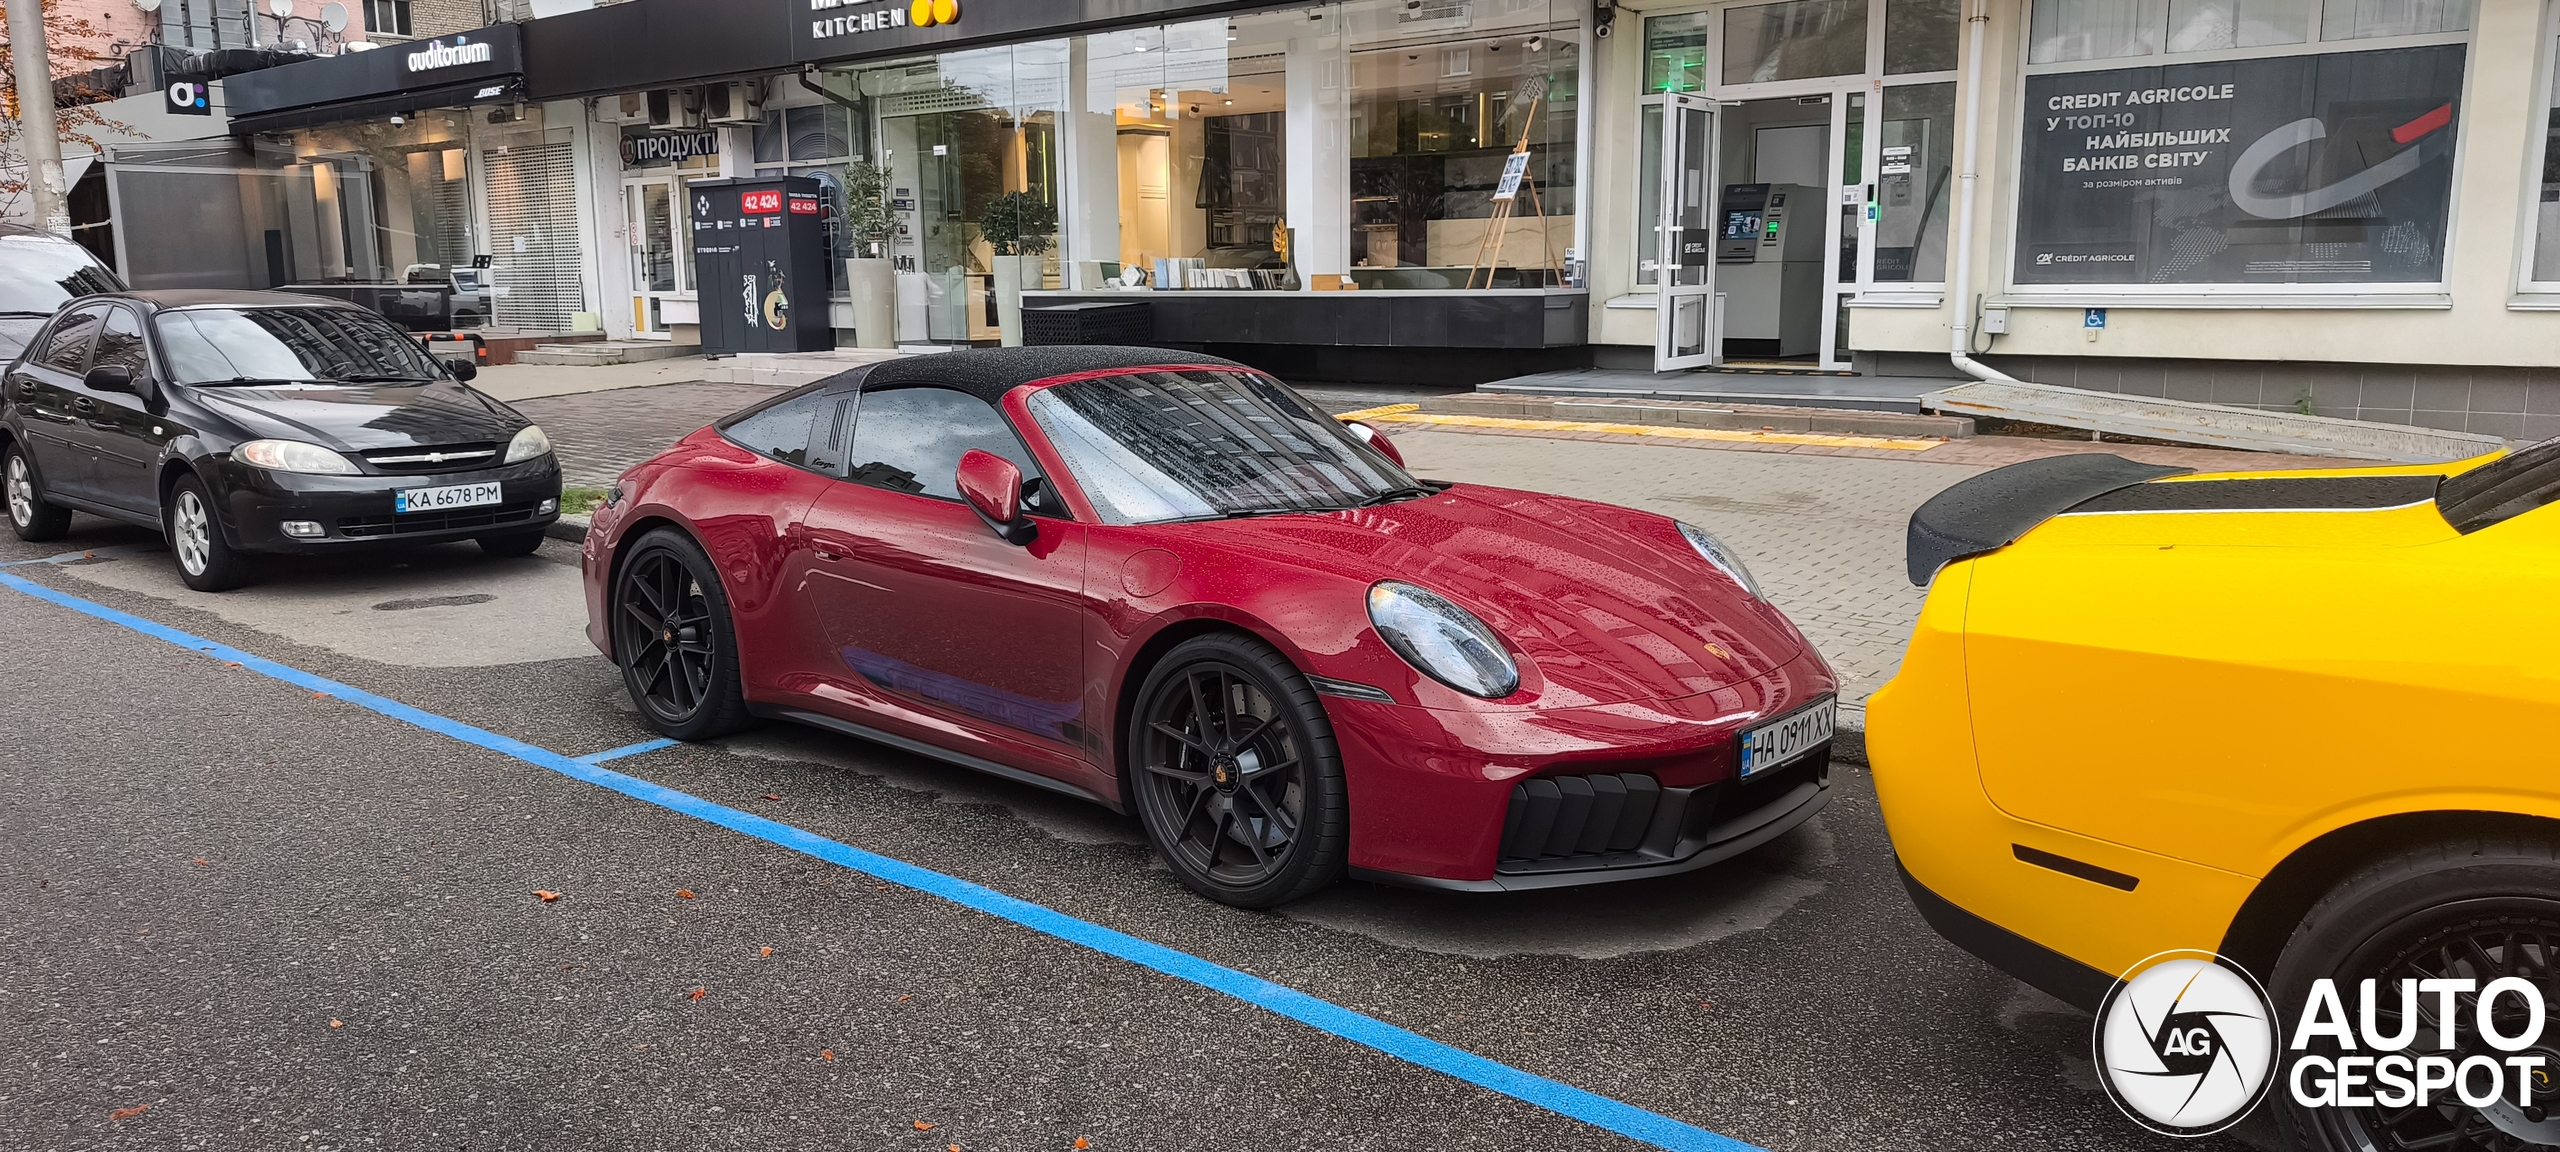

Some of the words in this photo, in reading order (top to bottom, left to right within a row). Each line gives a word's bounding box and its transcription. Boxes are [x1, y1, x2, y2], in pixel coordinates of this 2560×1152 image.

[813, 8, 905, 39] KITCHEN
[408, 35, 490, 72] auditorium
[474, 85, 505, 99] BOSE
[2048, 92, 2121, 111] CREDIT
[2125, 84, 2235, 106] AGRICOLE
[2046, 117, 2061, 131] У
[2065, 112, 2135, 130] ТОП-10
[2086, 128, 2232, 150] НАЙБІЛЬШИХ
[2062, 154, 2139, 172] БАНКІВ
[2082, 180, 2094, 188] за
[2096, 178, 2142, 189] розміром
[2144, 176, 2182, 186] активів
[744, 196, 758, 210] 42
[760, 194, 778, 208] 424
[790, 202, 801, 211] 42
[802, 202, 817, 211] 424
[822, 222, 840, 232] EPSI
[2055, 254, 2087, 262] CRÉDIT
[2088, 254, 2135, 262] AGRICOLE
[407, 492, 431, 508] KA
[436, 488, 472, 505] 6678
[476, 485, 498, 502] PM
[1751, 730, 1775, 767] HA
[1780, 713, 1811, 755] 0911
[1813, 703, 1833, 740] XX
[1741, 759, 1750, 770] UA
